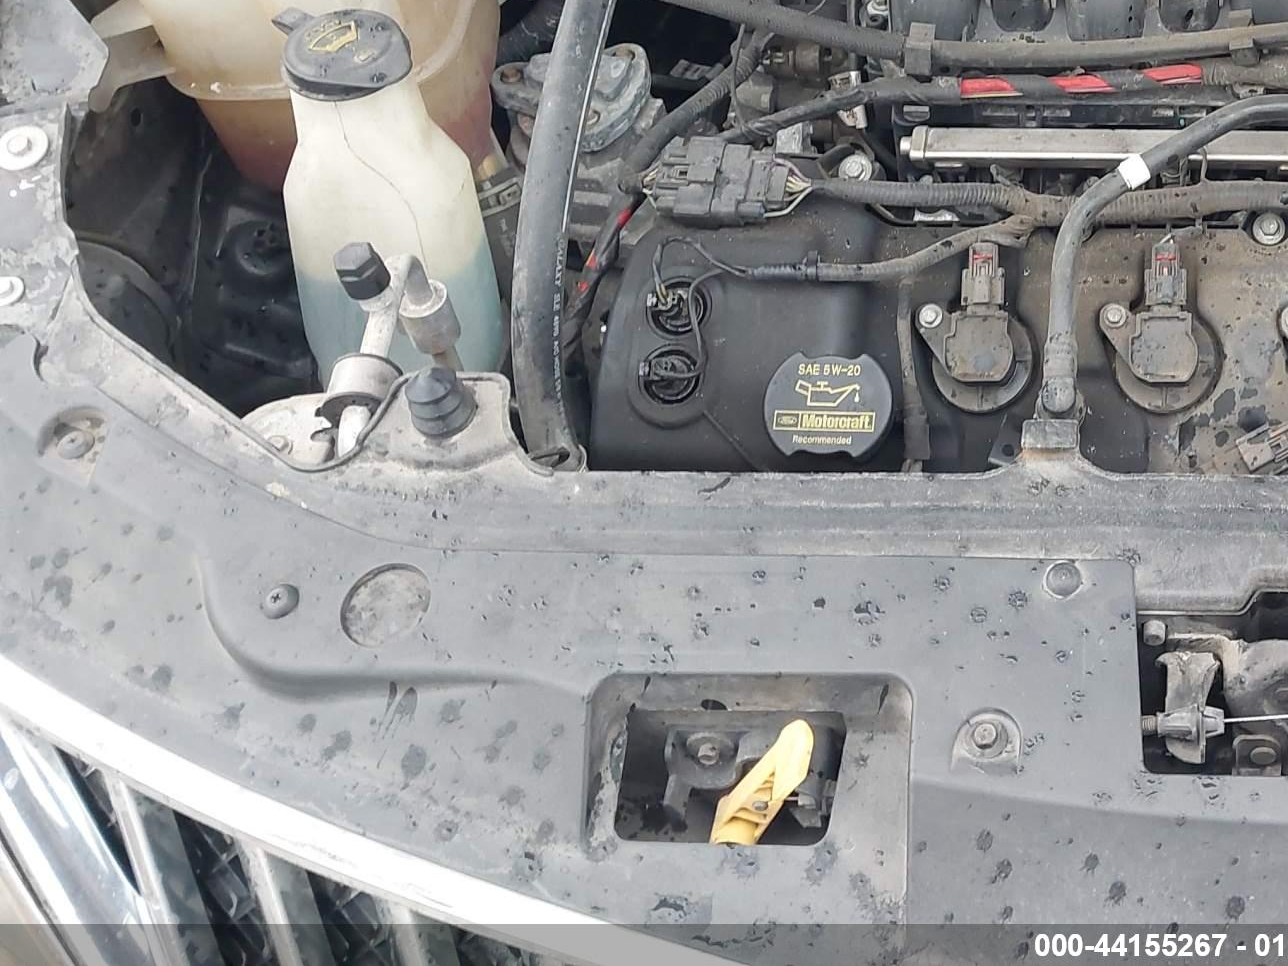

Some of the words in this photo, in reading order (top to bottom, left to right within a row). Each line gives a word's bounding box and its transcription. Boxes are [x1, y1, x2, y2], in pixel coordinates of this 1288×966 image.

[798, 363, 820, 376] SAE
[823, 364, 861, 376] 5W-20
[802, 414, 871, 429] Motorcraft
[792, 435, 852, 445] Recommended
